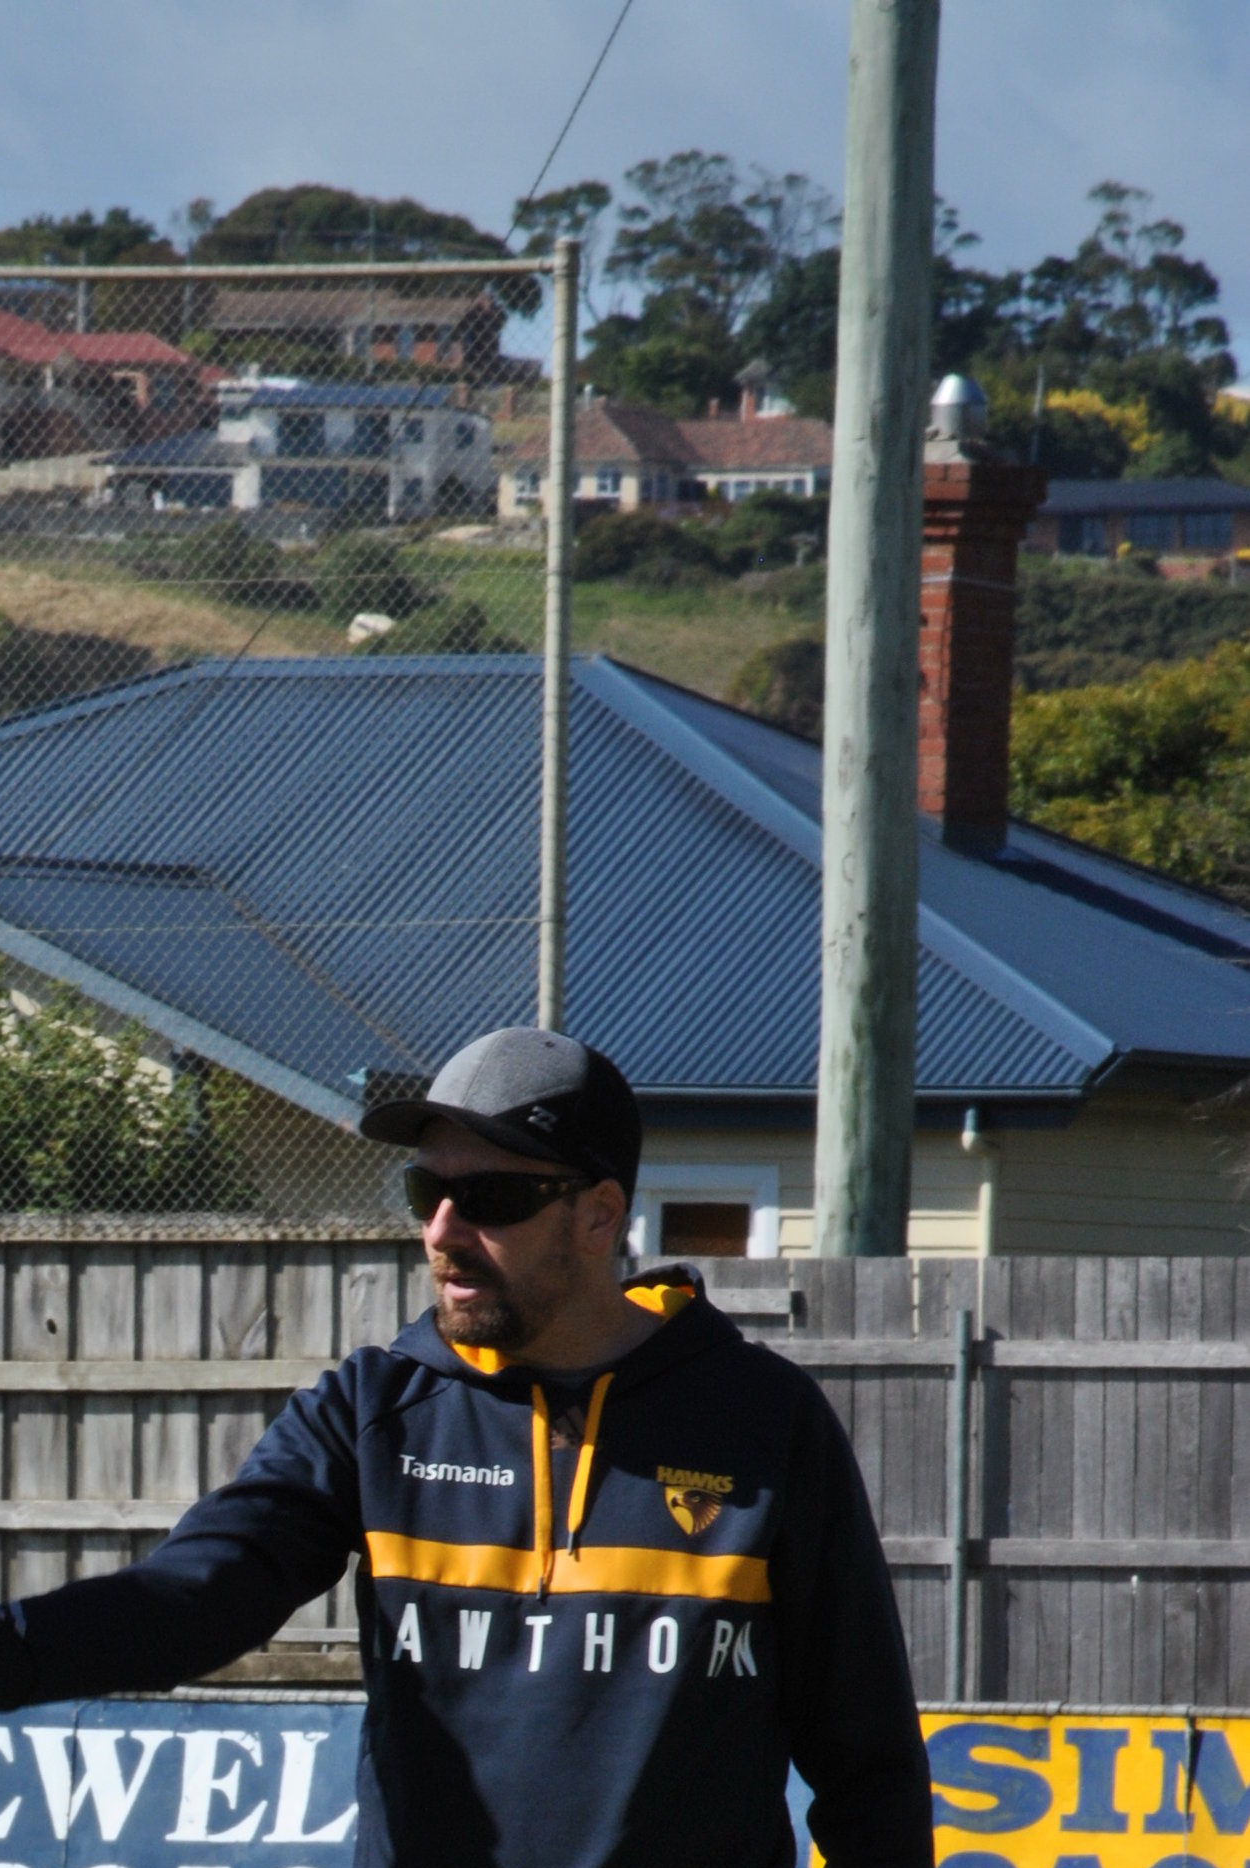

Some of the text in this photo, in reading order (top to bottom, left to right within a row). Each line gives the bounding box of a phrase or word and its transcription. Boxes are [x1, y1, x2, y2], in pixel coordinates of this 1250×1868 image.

[399, 1454, 515, 1487] Tasmania
[656, 1465, 734, 1494] HAWKS
[374, 1602, 758, 1678] AWTHORN
